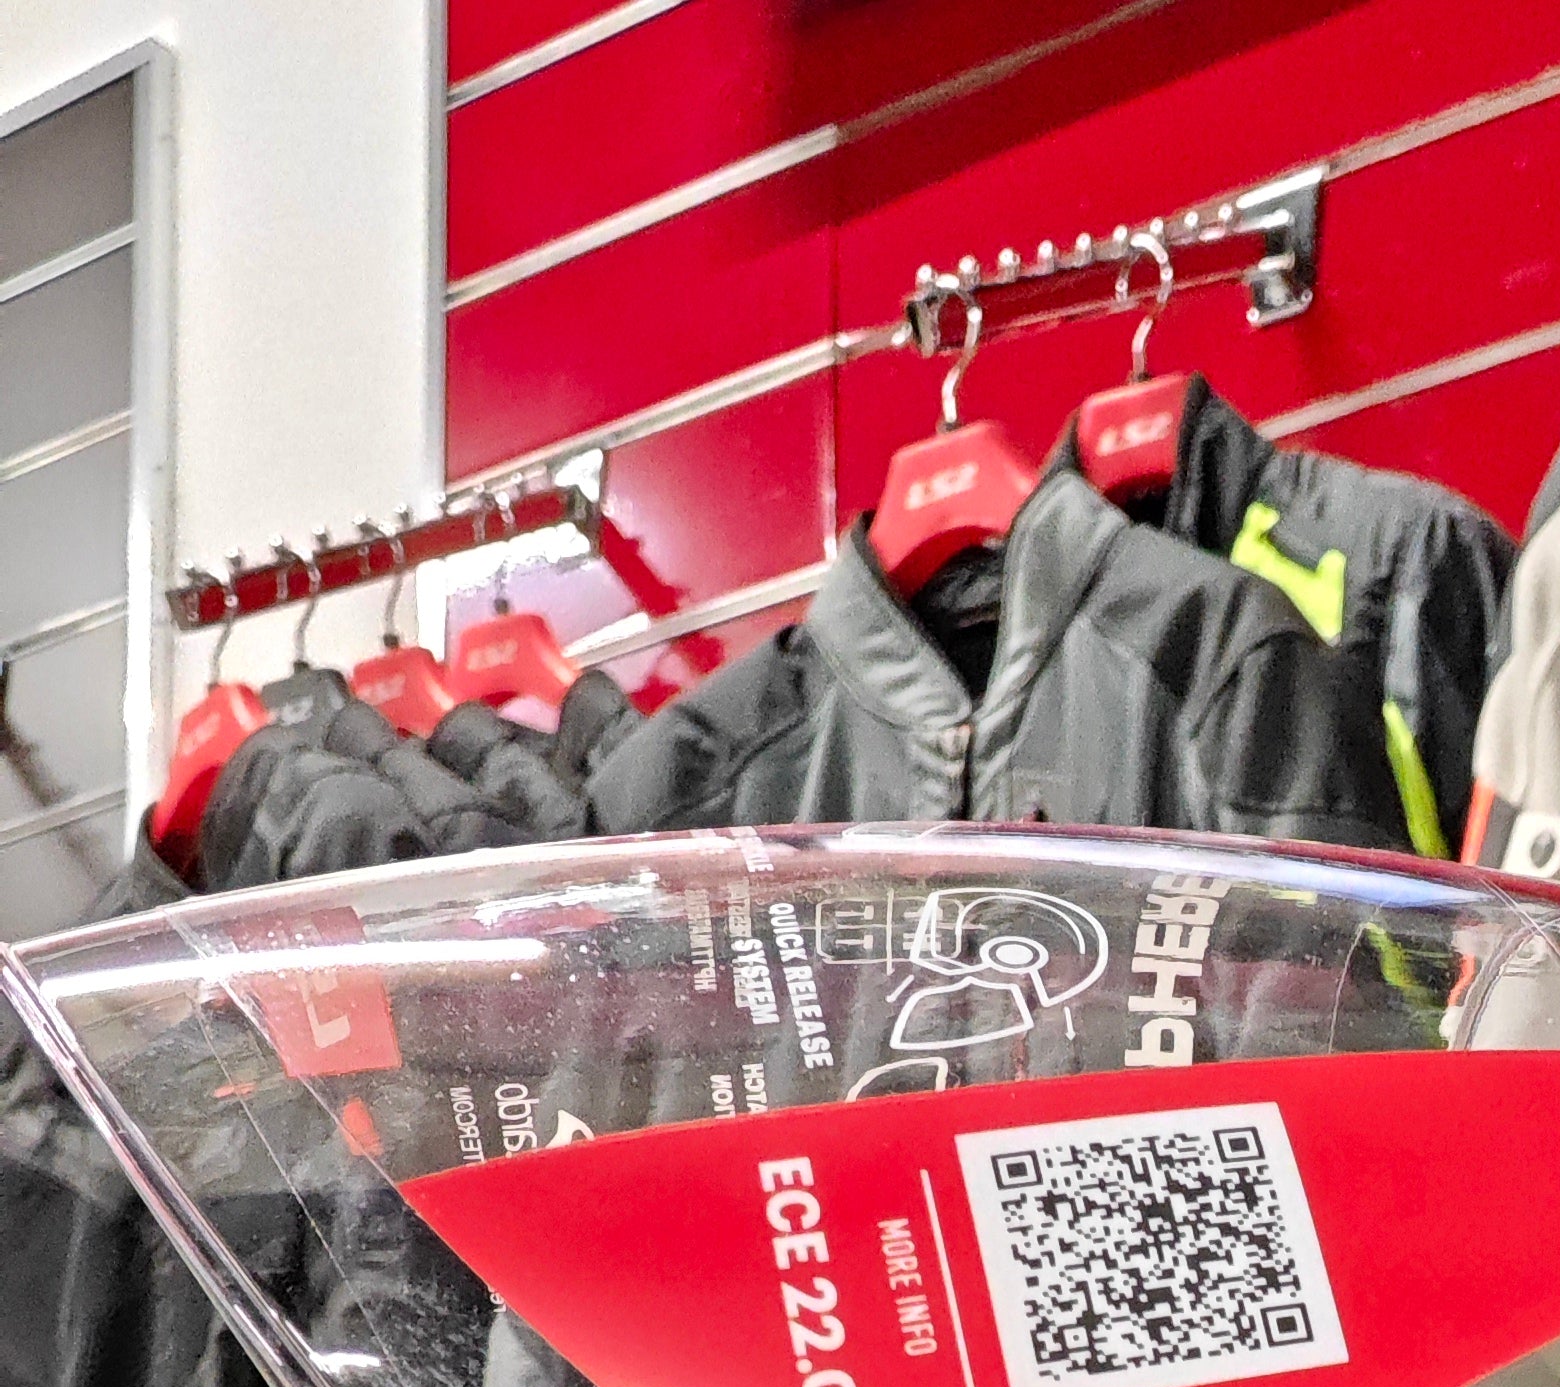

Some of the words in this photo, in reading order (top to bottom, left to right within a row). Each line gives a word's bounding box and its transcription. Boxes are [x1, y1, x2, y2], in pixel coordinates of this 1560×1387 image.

[769, 902, 808, 962] QUICK
[731, 938, 780, 1025] SYSTEM
[783, 965, 834, 1070] RELEASE
[758, 1156, 830, 1270] ECE
[877, 1217, 923, 1291] MORE
[896, 1294, 938, 1356] INFO
